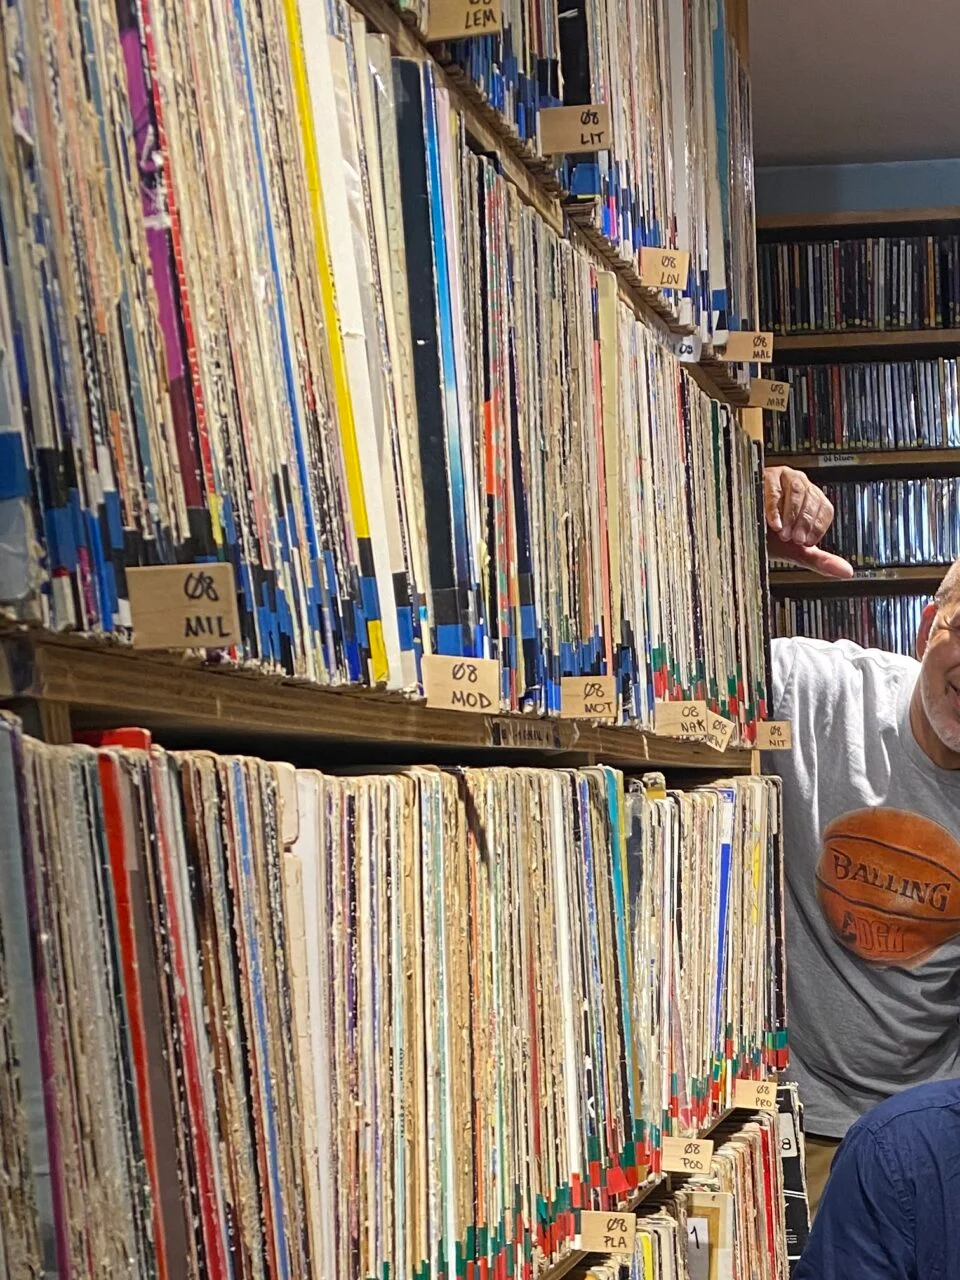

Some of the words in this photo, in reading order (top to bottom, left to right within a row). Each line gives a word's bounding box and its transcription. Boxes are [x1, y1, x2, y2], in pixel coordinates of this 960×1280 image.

[465, 10, 497, 29] LEM
[581, 132, 604, 145] LIT
[660, 271, 680, 285] LOV
[752, 350, 771, 359] MAL
[184, 615, 231, 639] MIL
[451, 689, 492, 710] MOD
[584, 702, 613, 714] MOT
[680, 719, 707, 734] NAK
[769, 738, 787, 748] NIT
[830, 847, 952, 912] BALLING
[755, 1097, 773, 1109] PRO
[603, 1235, 628, 1249] PLA
